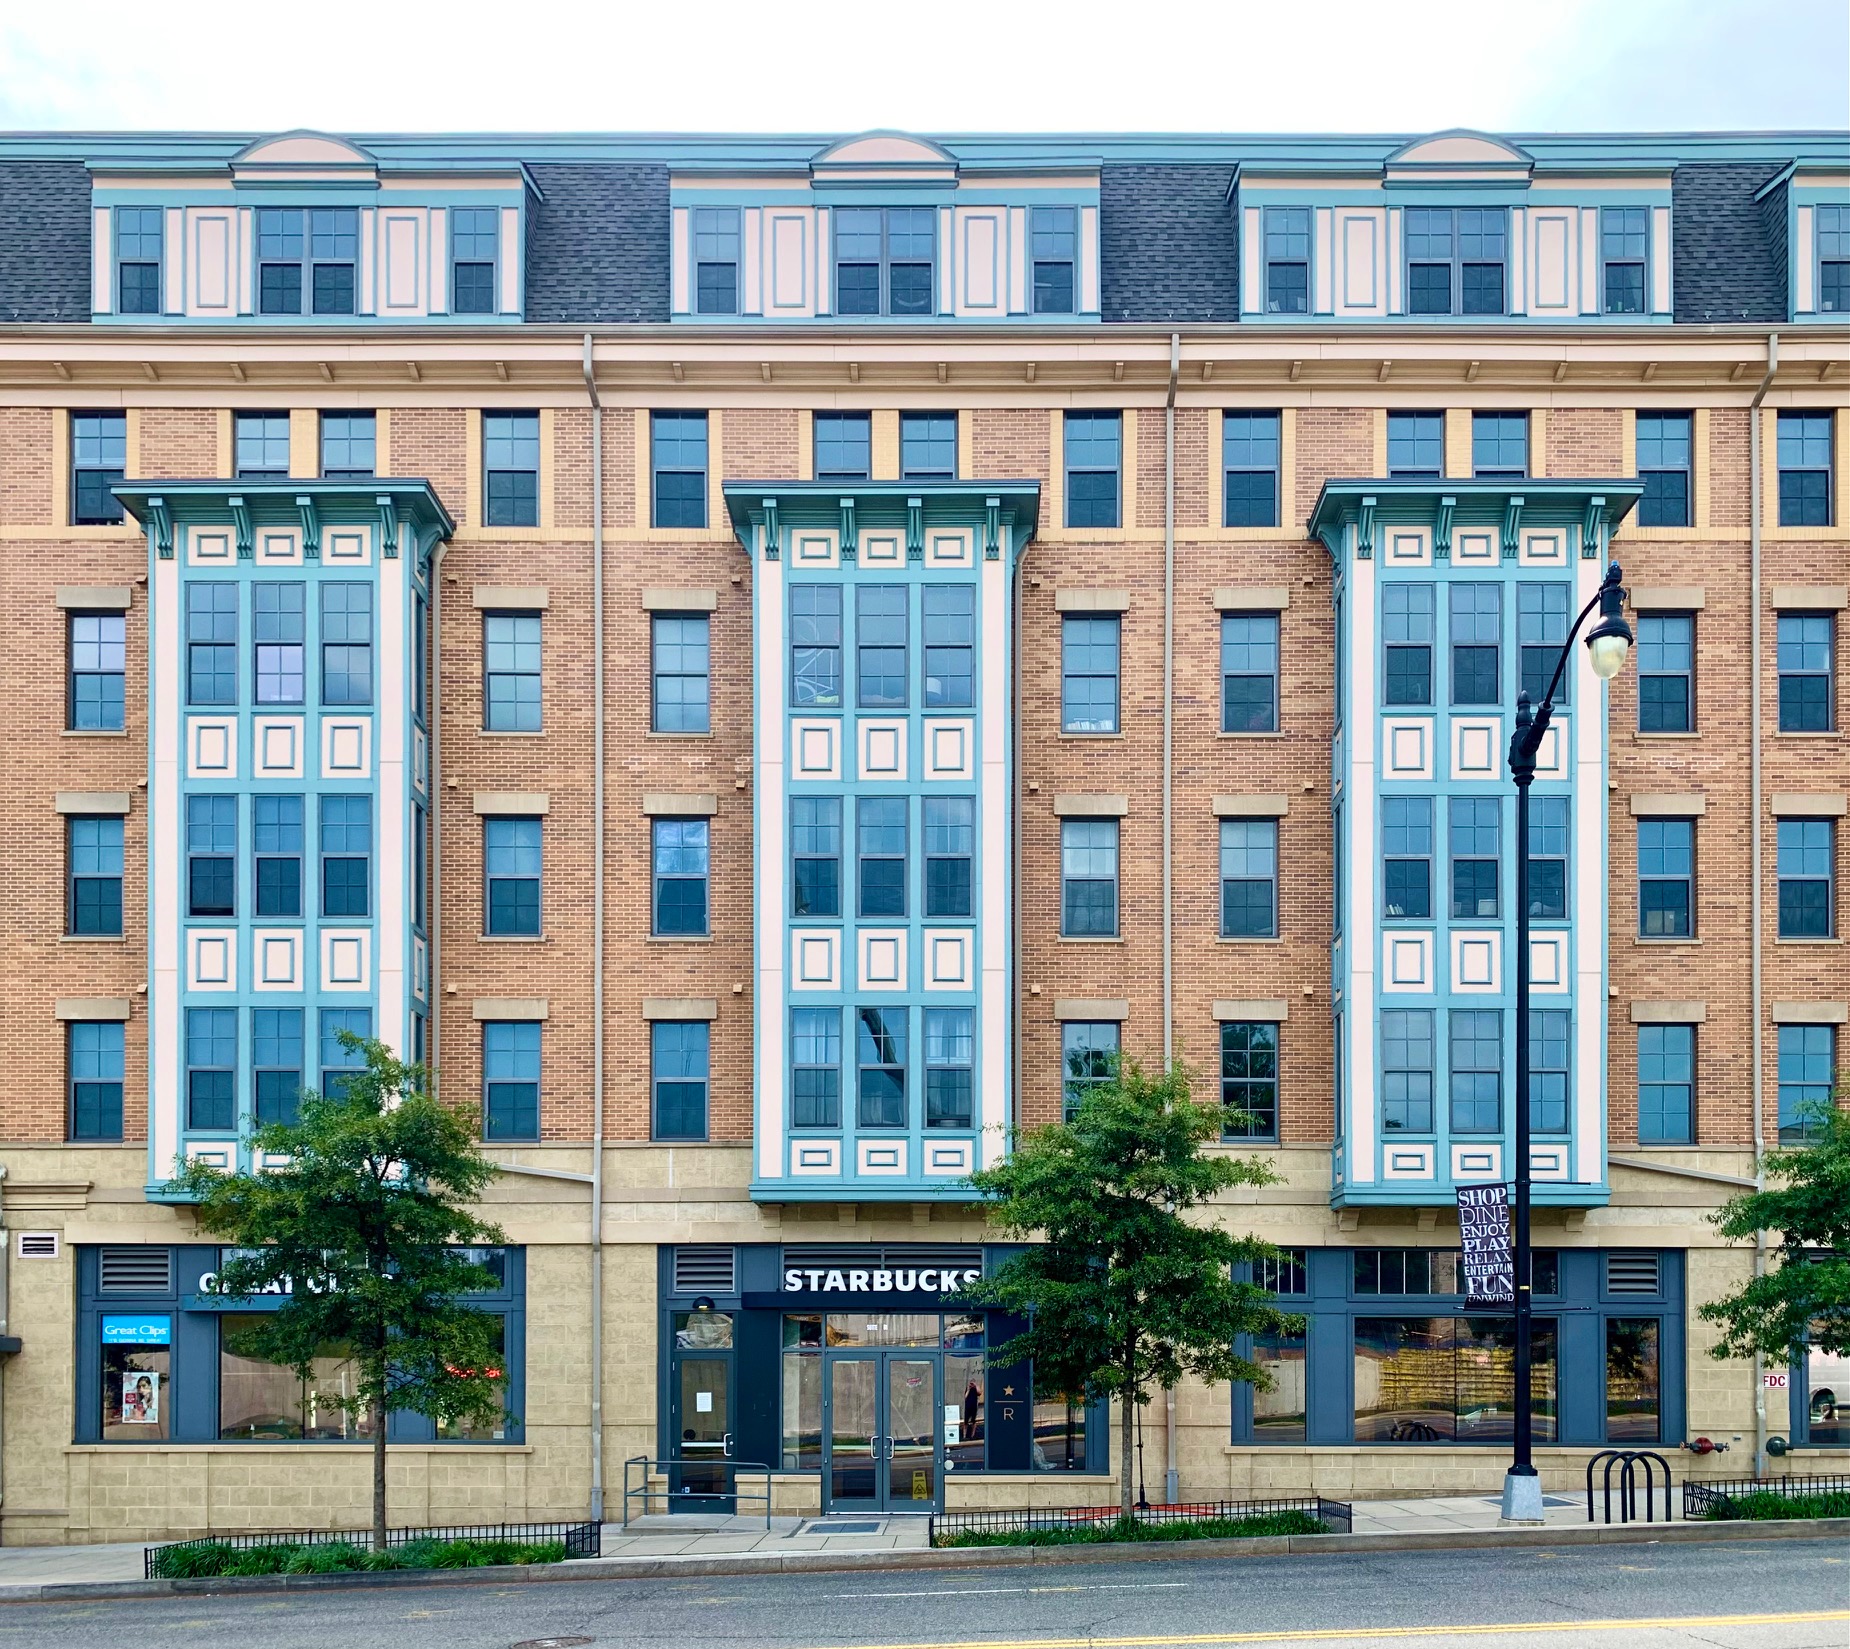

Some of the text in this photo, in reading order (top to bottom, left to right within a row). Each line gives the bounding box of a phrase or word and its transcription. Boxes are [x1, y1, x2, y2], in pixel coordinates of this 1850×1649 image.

[1458, 1187, 1506, 1207] SHOP
[1459, 1205, 1510, 1226] DINE
[1461, 1222, 1510, 1238] ENJOY
[1462, 1236, 1511, 1253] PLAY
[1464, 1250, 1512, 1265] RELAX
[1464, 1262, 1514, 1276] ENTERTAIN
[784, 1269, 981, 1292] STARBUCKS
[1466, 1273, 1514, 1295] FUN
[1468, 1292, 1515, 1303] UNWIND
[104, 1325, 167, 1338] Great Clips
[1763, 1375, 1786, 1386] FDC
[1003, 1407, 1014, 1420] R
